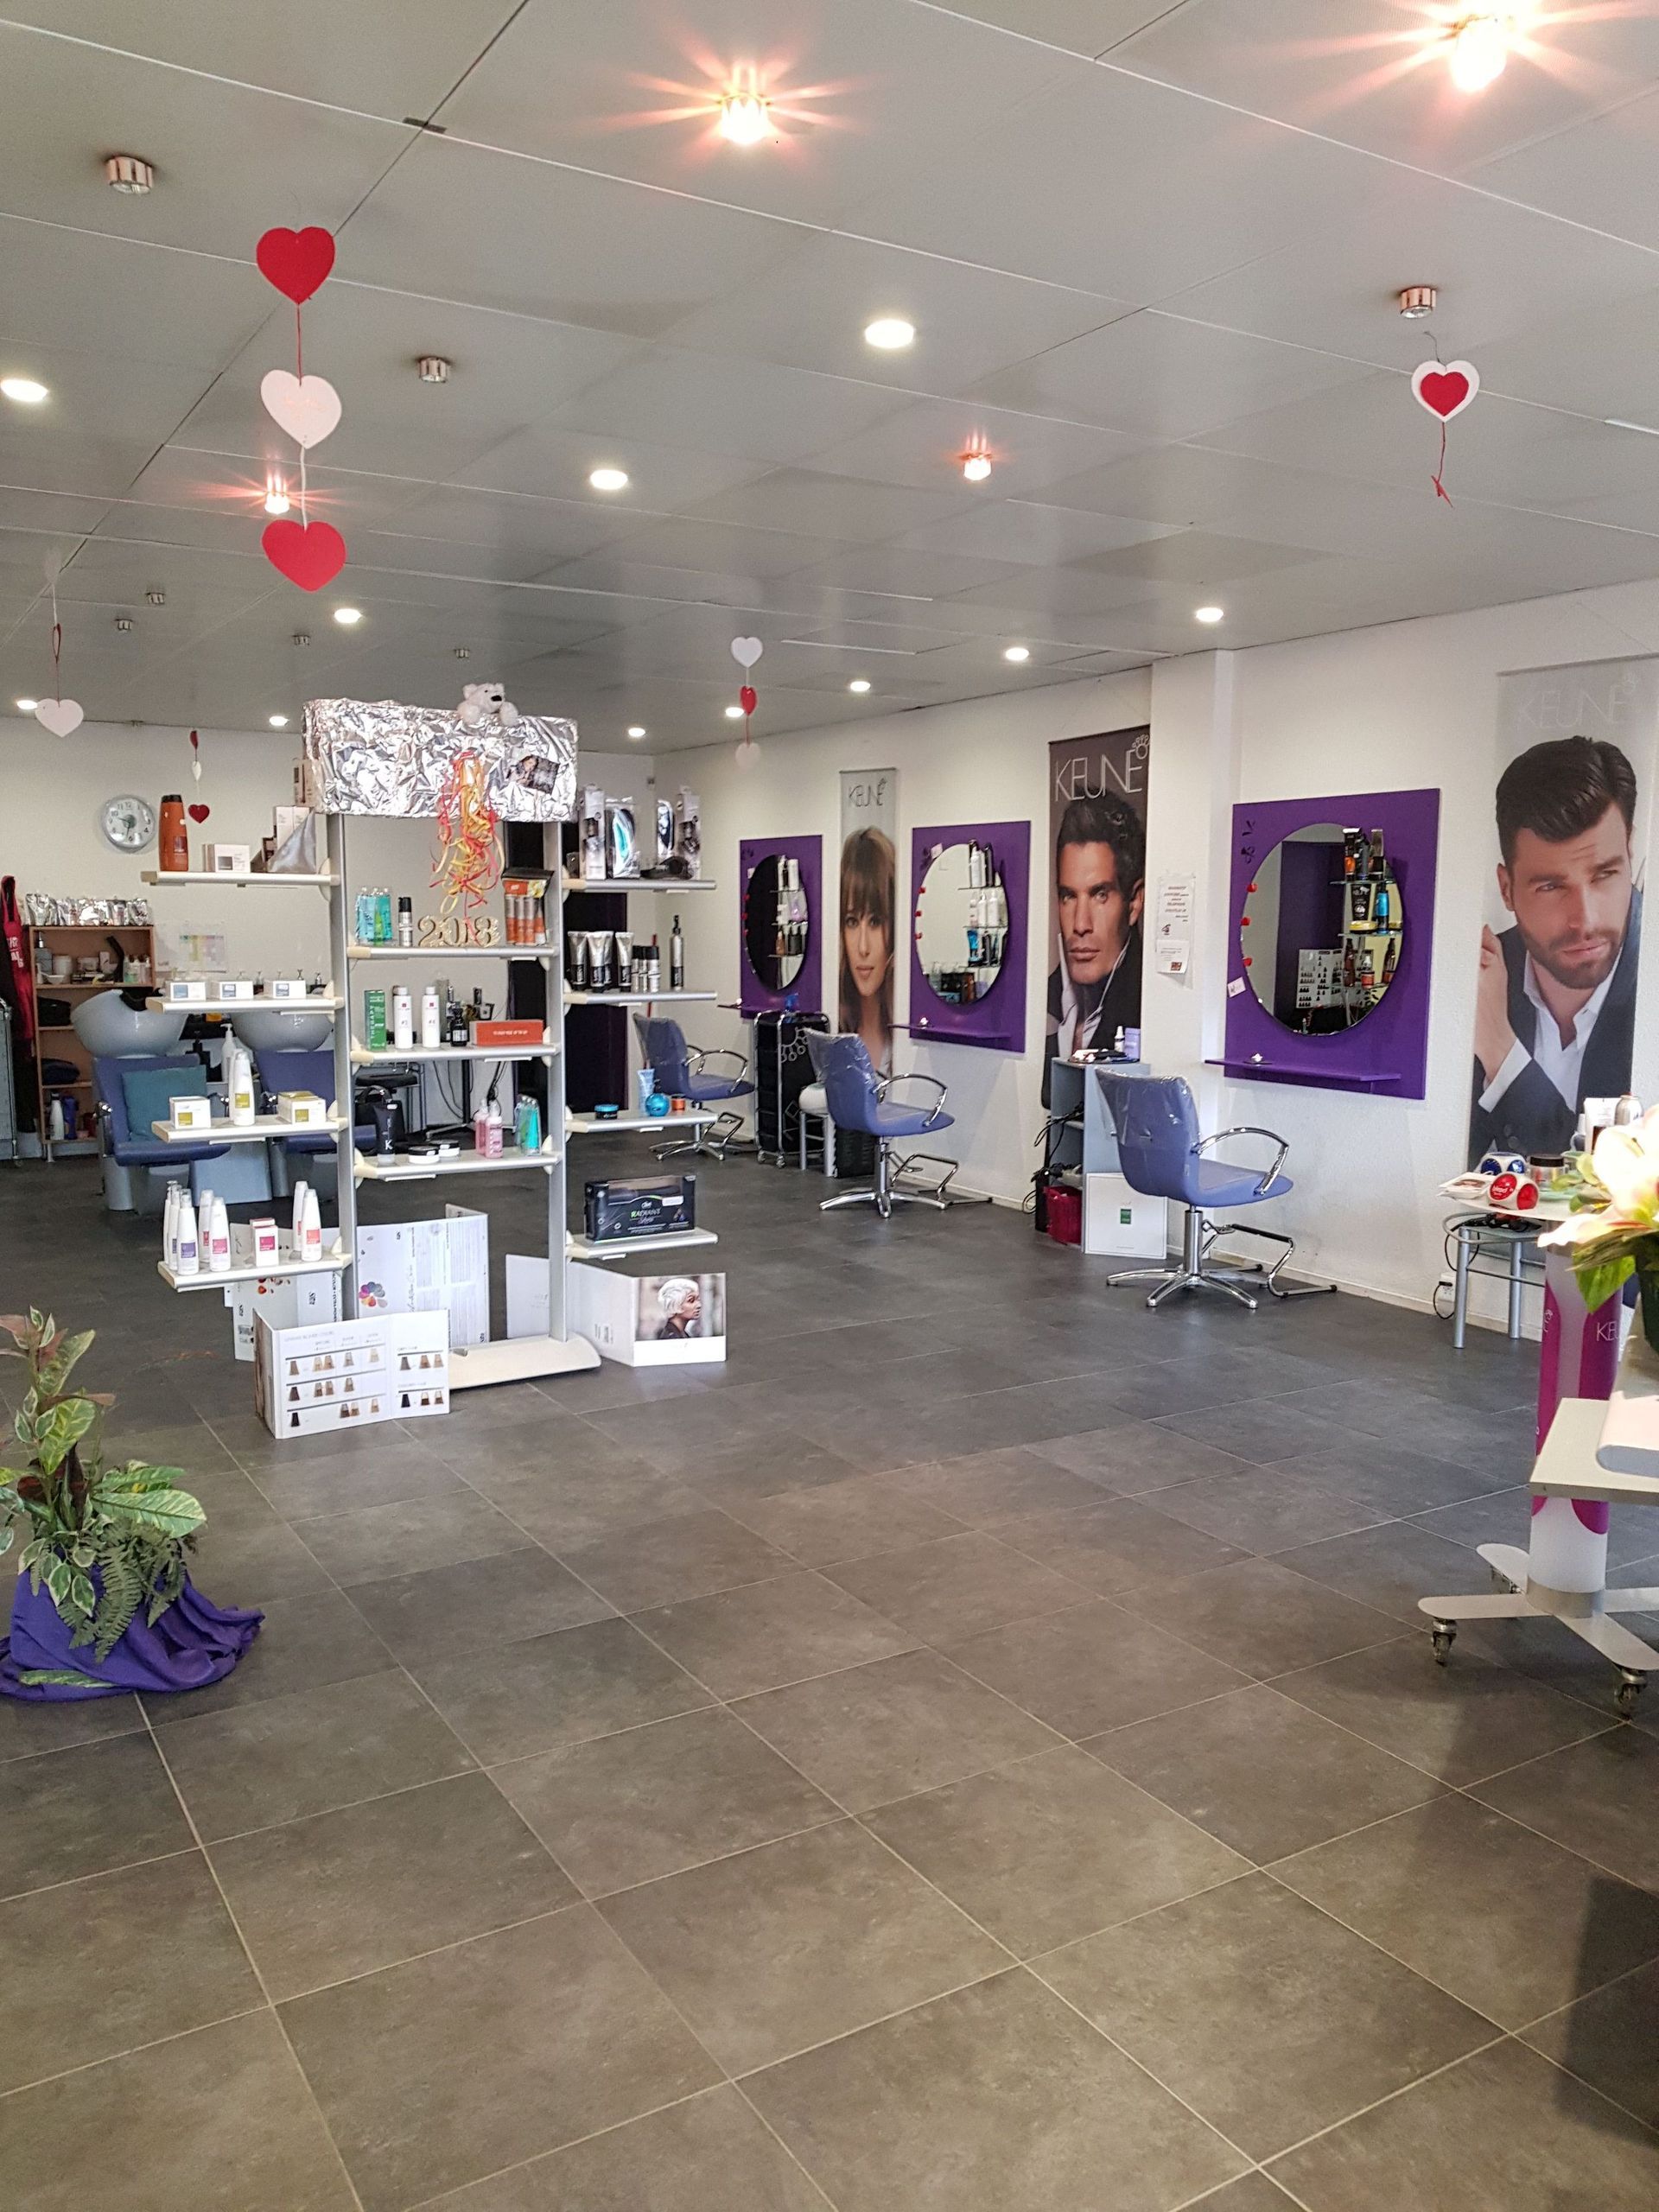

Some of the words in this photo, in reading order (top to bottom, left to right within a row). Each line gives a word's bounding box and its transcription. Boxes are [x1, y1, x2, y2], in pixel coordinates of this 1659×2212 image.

[1514, 683, 1626, 732] KEUNE
[848, 780, 885, 807] KEUNE
[1055, 748, 1142, 802] KEUNE
[417, 915, 501, 947] 2018
